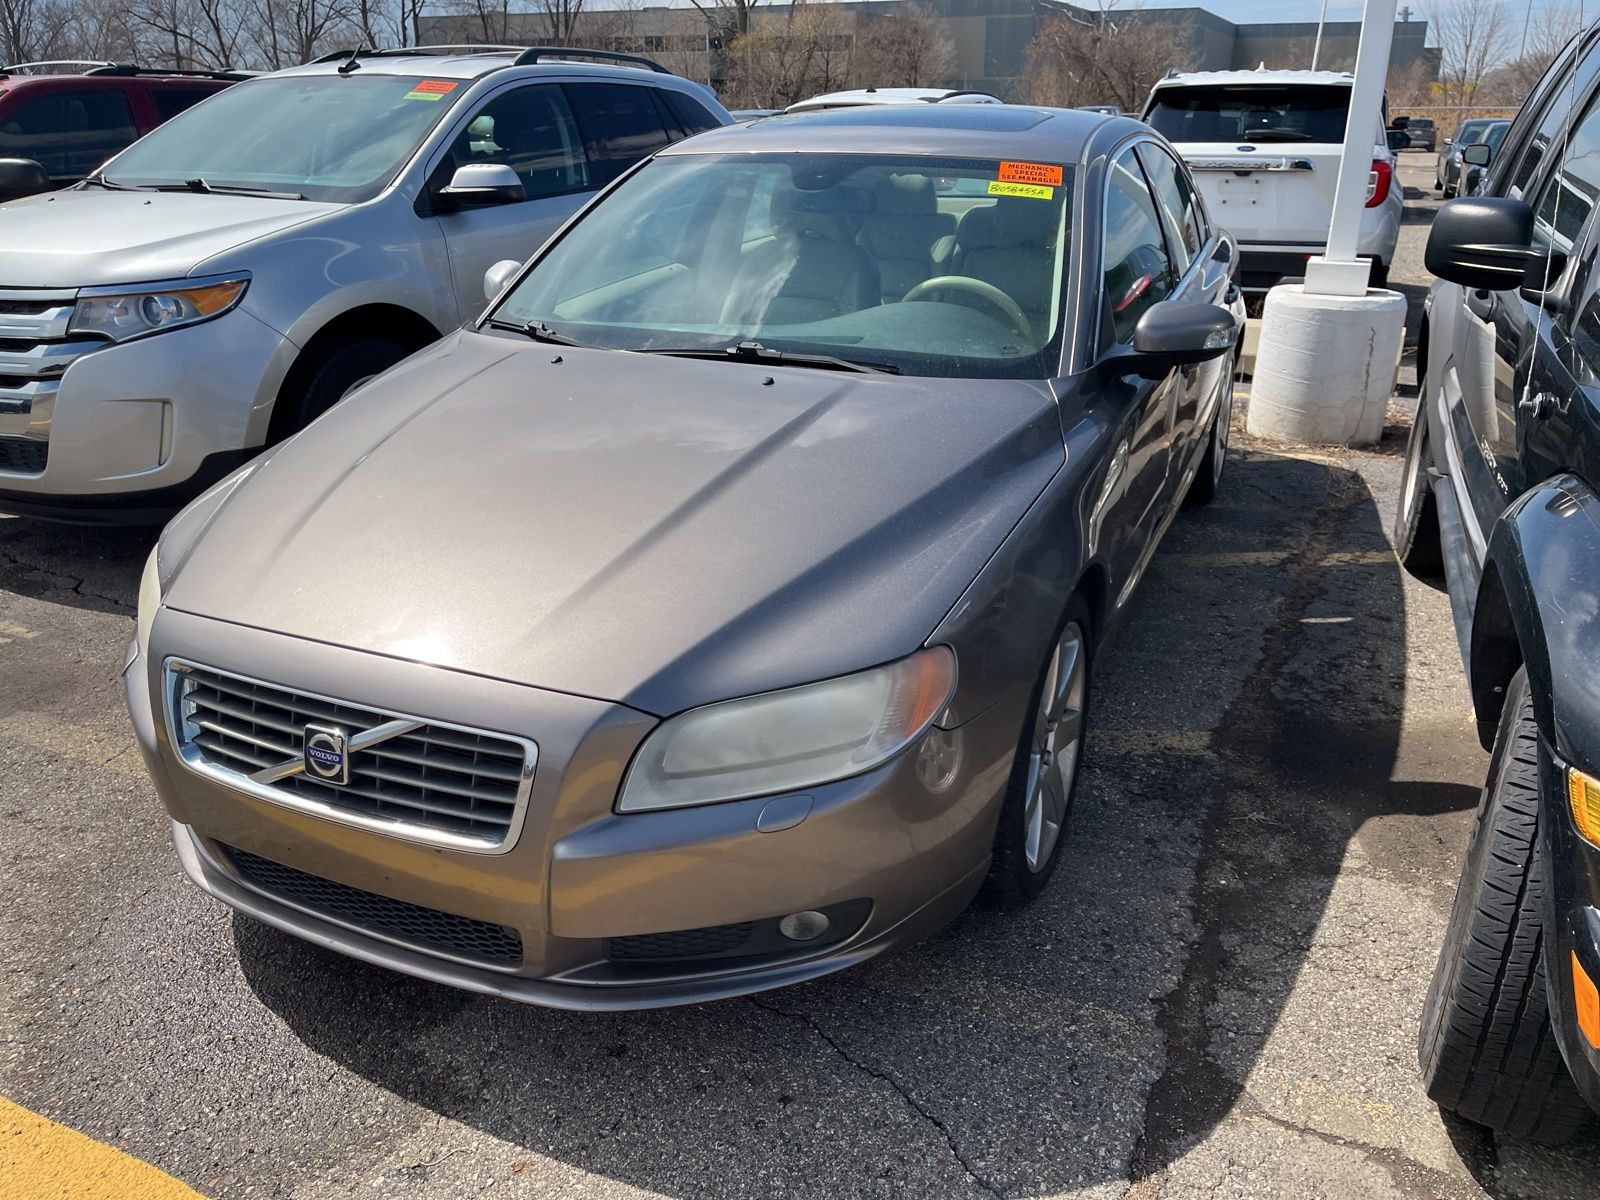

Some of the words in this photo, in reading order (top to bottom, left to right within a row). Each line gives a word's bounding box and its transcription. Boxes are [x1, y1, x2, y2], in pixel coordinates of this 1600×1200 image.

[1008, 163, 1055, 173] MECHANICS
[1014, 169, 1047, 177] SPECIAL
[1018, 175, 1060, 184] MANAGER
[310, 749, 340, 762] VOLVO
